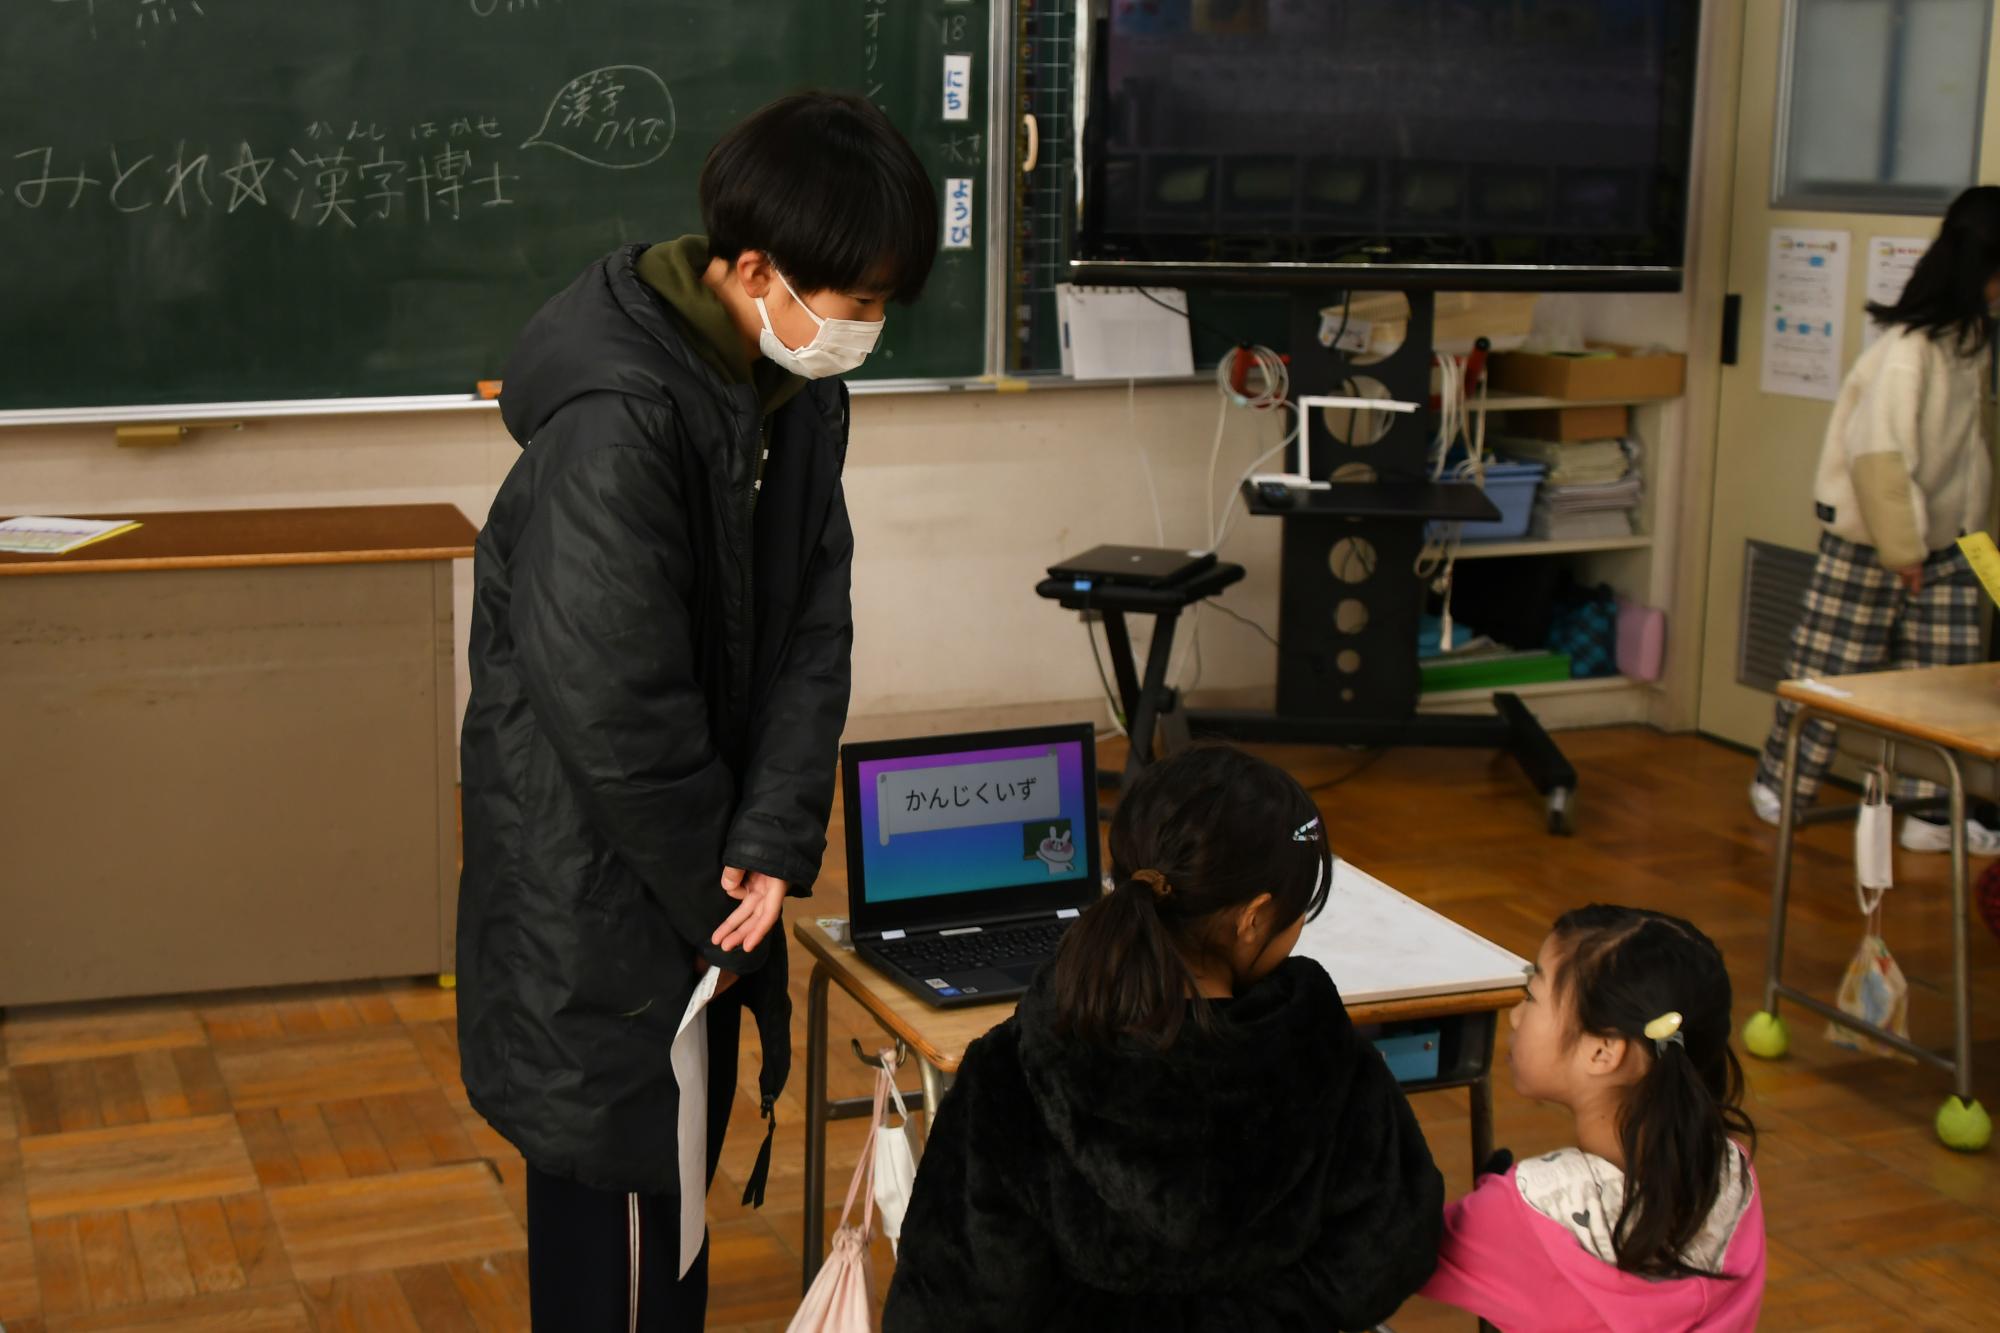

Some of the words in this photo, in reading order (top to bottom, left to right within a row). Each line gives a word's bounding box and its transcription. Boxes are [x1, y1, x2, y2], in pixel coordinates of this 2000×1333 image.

[942, 15, 967, 44] 18
[946, 70, 963, 111] にち
[409, 116, 502, 140] はかせ
[593, 117, 666, 150] クイズ
[952, 180, 972, 244] ようび
[905, 777, 1038, 813] かんじくいず
